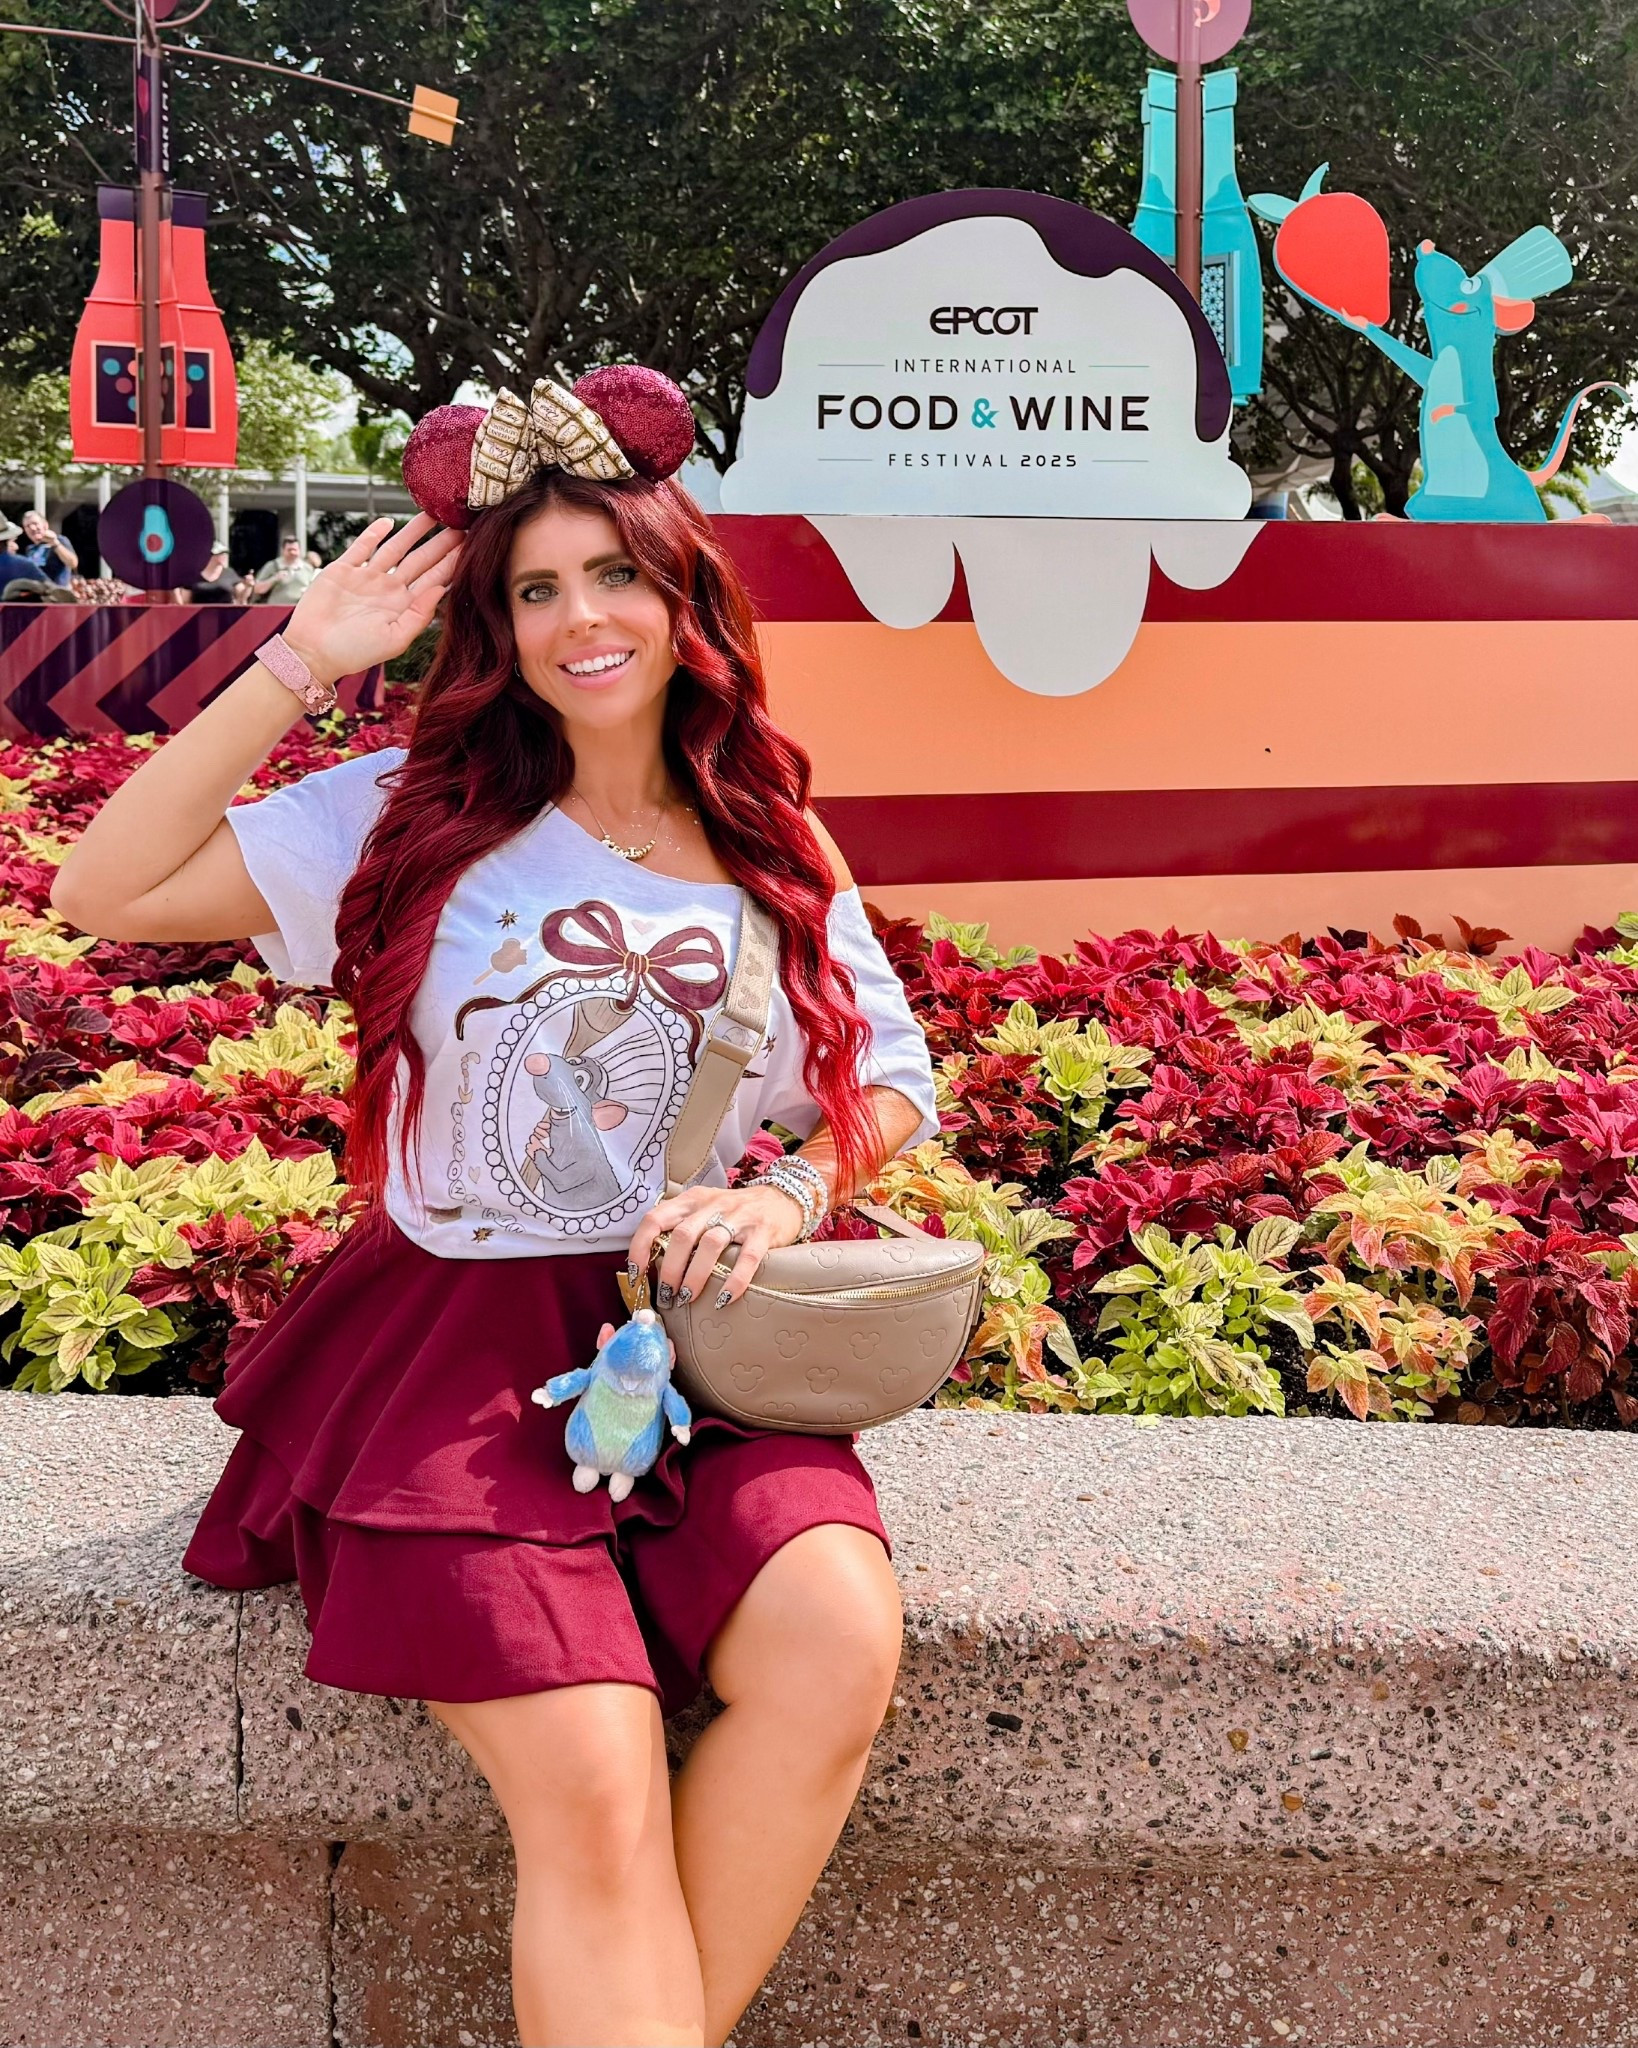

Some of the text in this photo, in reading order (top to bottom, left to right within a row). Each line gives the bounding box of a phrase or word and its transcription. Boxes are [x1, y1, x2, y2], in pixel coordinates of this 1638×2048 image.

[929, 306, 1039, 336] EPCOT
[894, 357, 1077, 375] INTERNATIONAL
[817, 394, 1150, 432] FOOD & WINE
[888, 453, 1077, 468] FESTIVAL 2025
